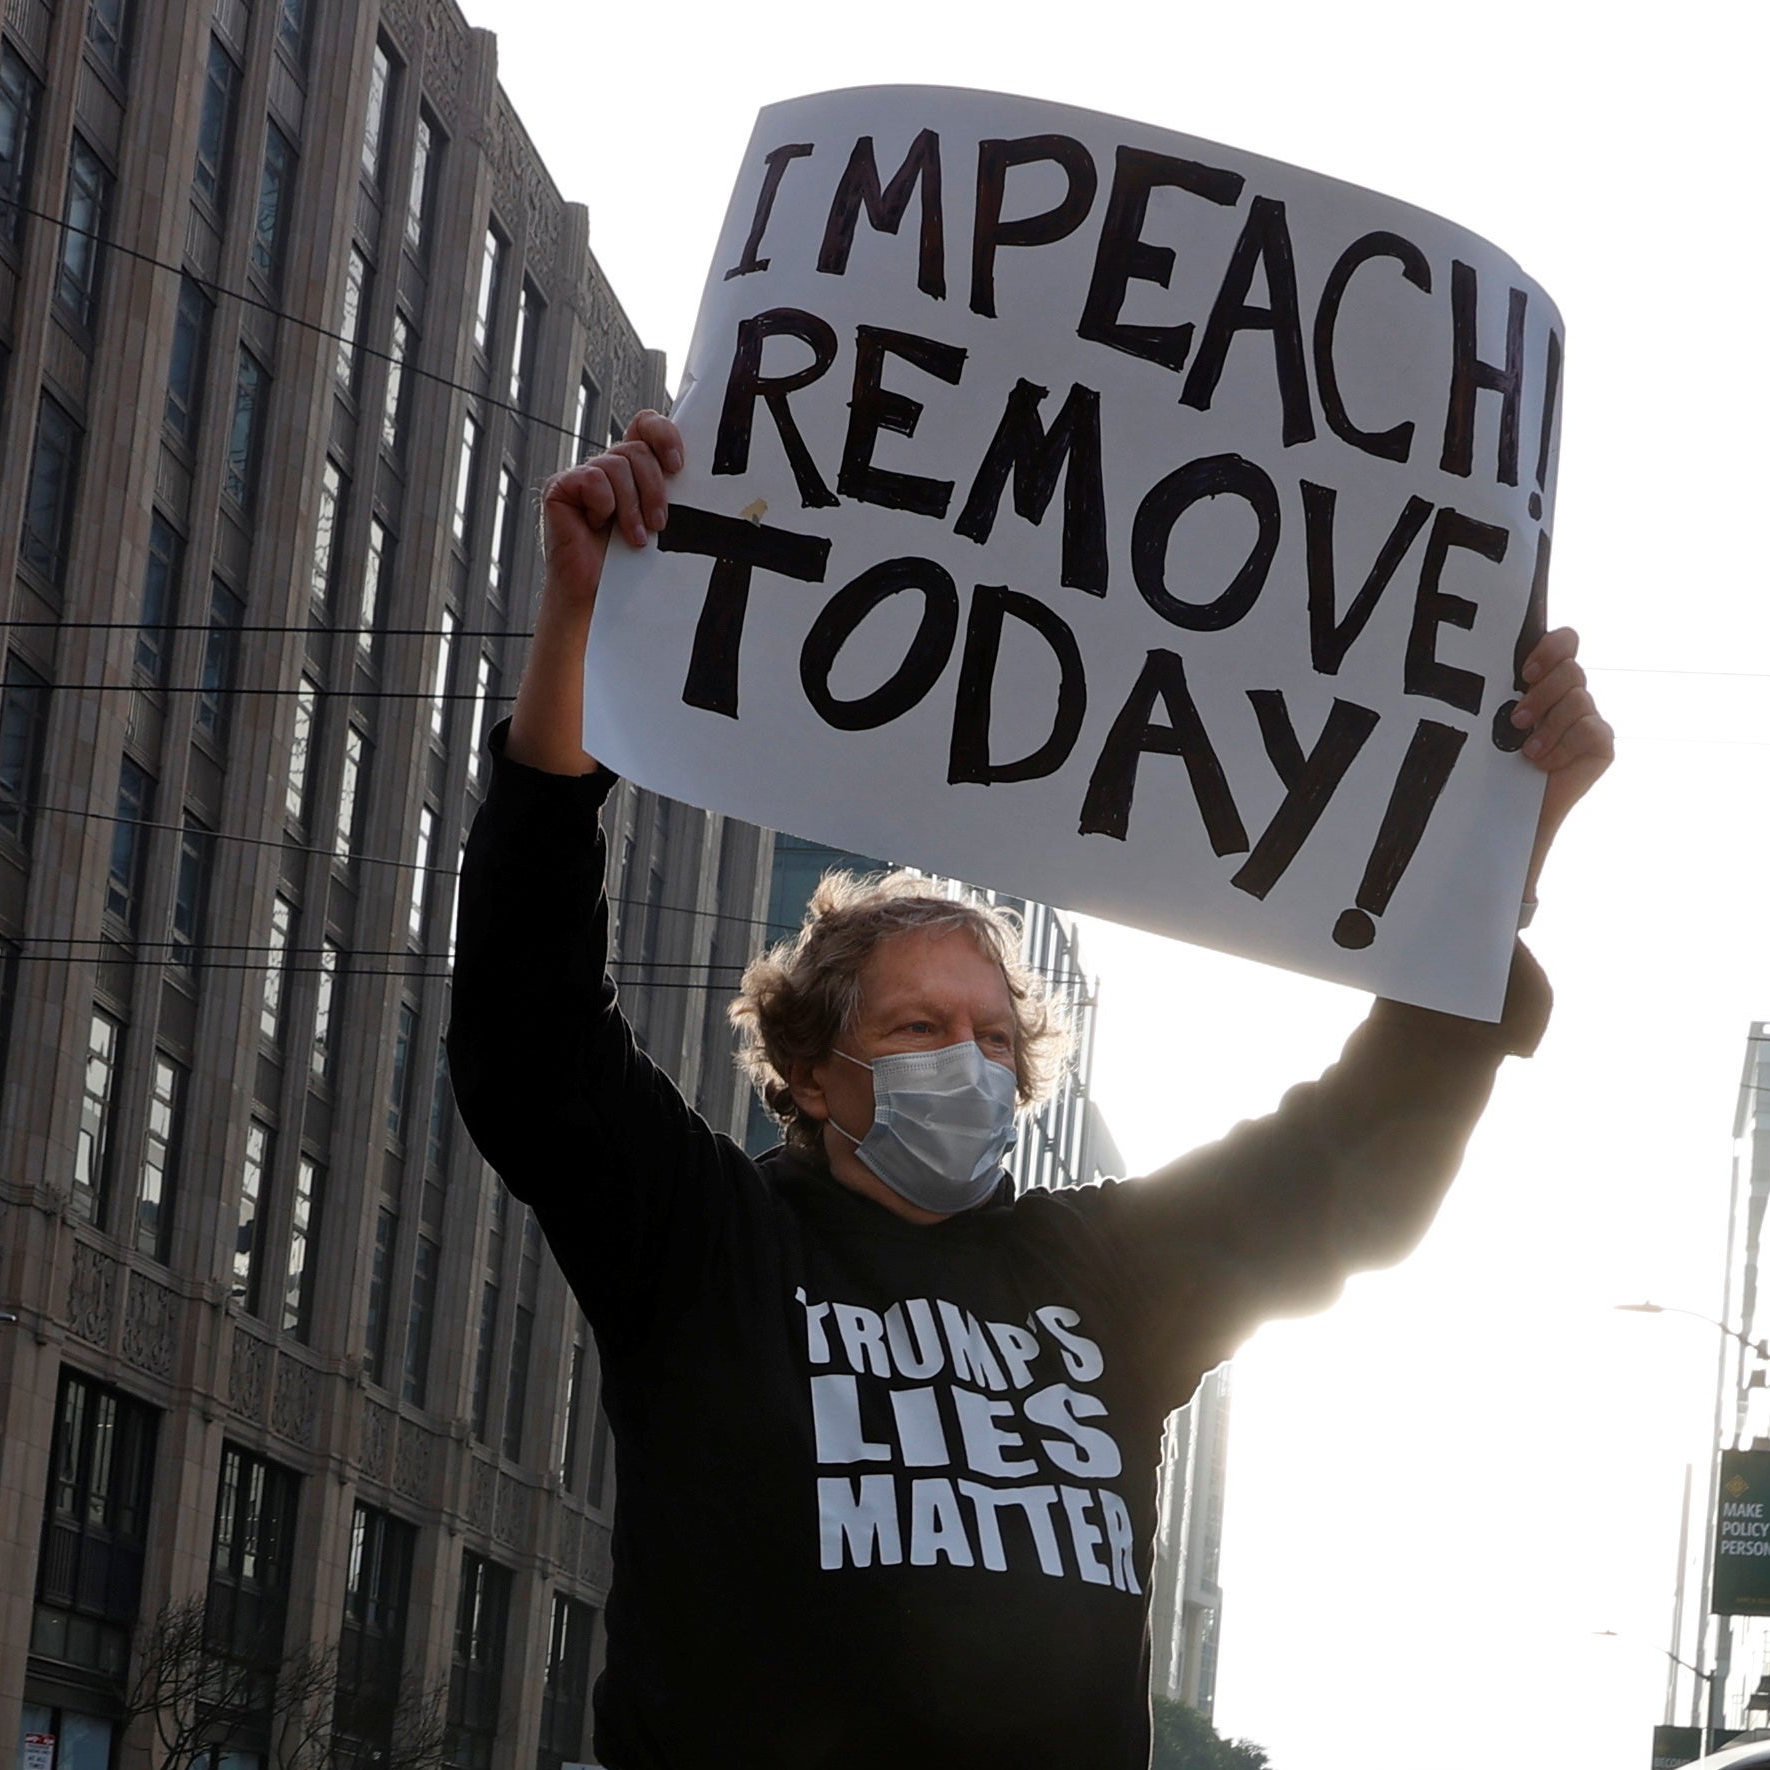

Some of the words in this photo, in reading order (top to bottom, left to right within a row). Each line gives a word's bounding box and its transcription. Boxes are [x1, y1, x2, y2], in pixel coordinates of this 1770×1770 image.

[724, 129, 1562, 521] IMPEACH!
[711, 306, 1551, 753] REMOVE!
[657, 503, 1468, 950] TODAY!
[794, 1286, 1104, 1391] TRUMP'S
[810, 1374, 1122, 1479] LIES
[817, 1474, 1142, 1596] MATTER
[1721, 1521, 1770, 1537] POLICY
[1723, 1502, 1764, 1518] MAKE
